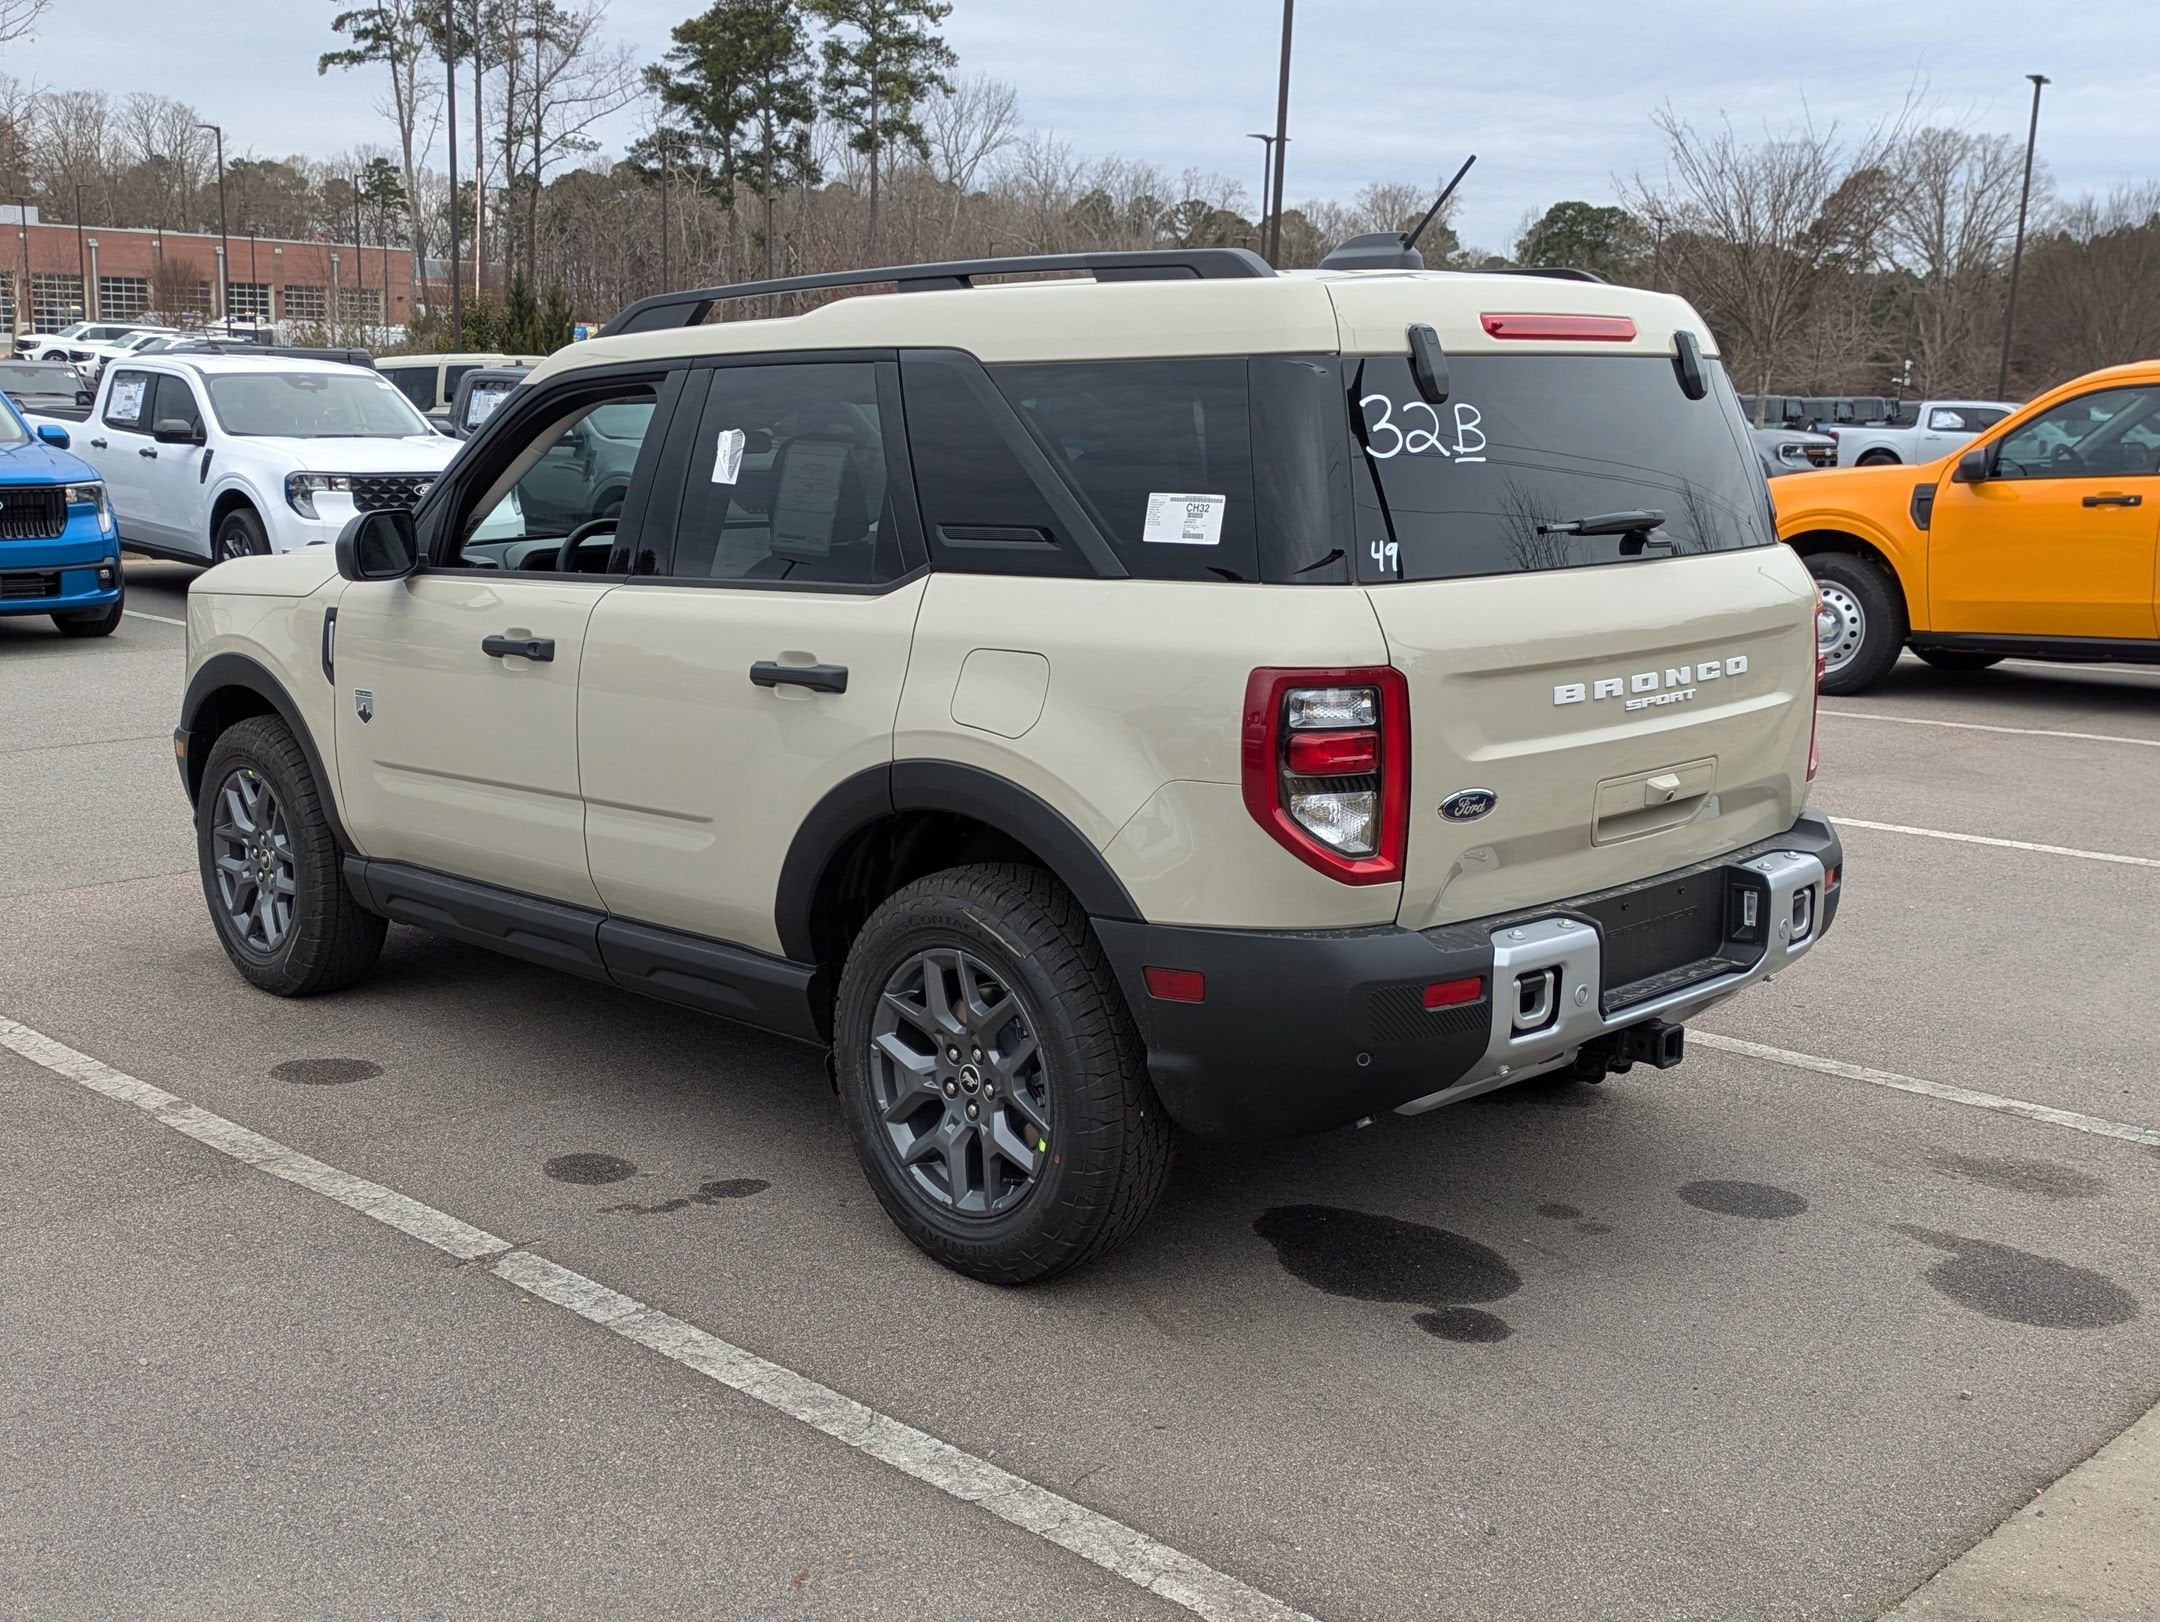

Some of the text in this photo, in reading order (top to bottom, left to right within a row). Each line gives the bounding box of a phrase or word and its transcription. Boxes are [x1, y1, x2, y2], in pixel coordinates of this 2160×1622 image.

[1359, 394, 1487, 459] 32B
[1186, 503, 1211, 513] CH32
[1371, 540, 1398, 572] 49
[1553, 655, 1748, 706] BRONCO
[1625, 688, 1697, 712] SPORT
[1454, 795, 1487, 816] Ford
